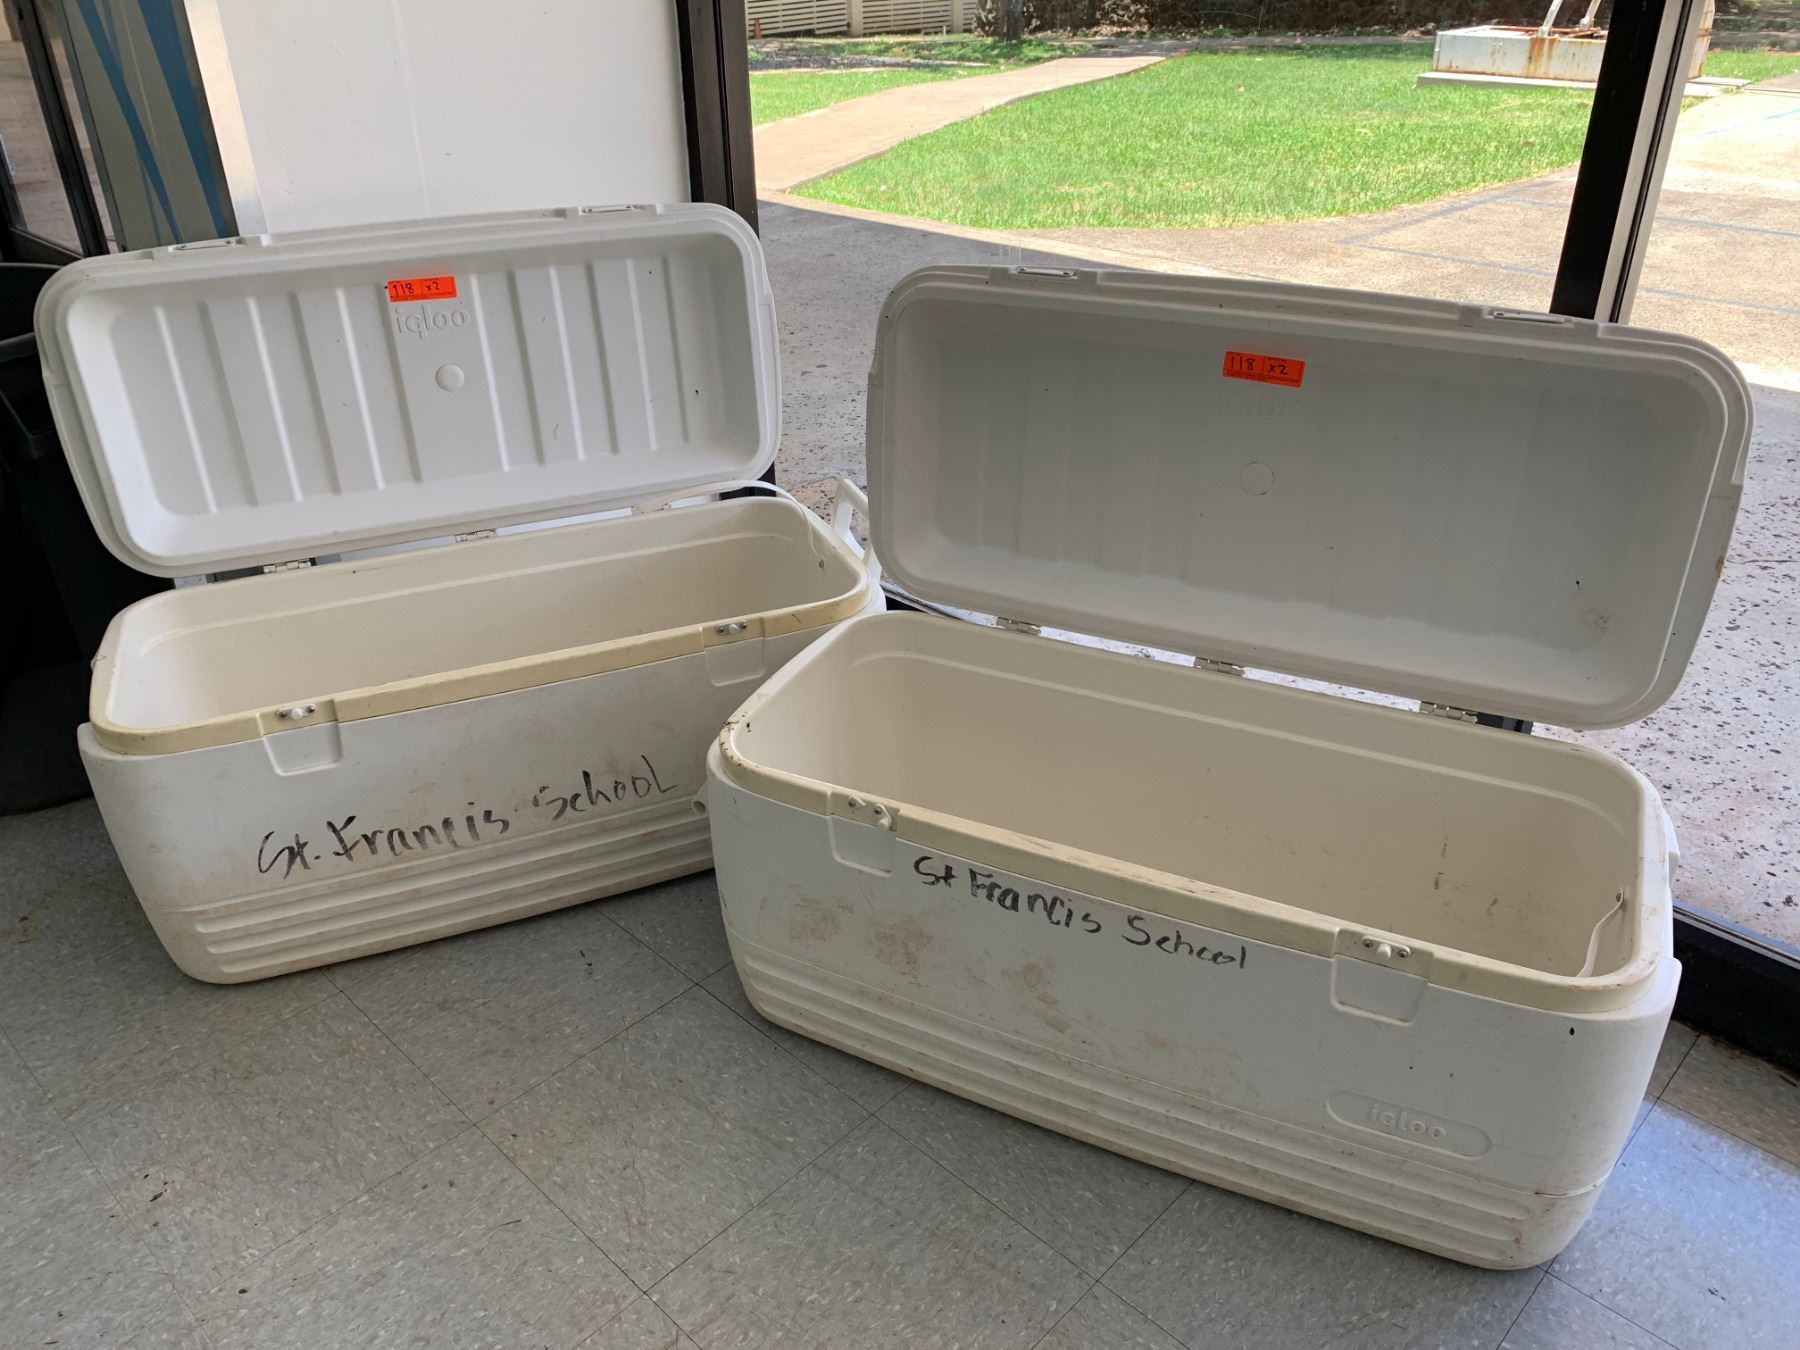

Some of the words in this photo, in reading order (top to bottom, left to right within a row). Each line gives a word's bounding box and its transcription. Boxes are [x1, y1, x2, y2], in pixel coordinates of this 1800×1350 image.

[392, 282, 415, 298] 118
[394, 305, 467, 339] igloo
[1231, 354, 1255, 371] 118
[1267, 363, 1288, 375] x2
[326, 802, 510, 863] Francis
[913, 855, 958, 888] St
[968, 868, 1102, 934] Francis
[1121, 914, 1247, 969] School
[1368, 1103, 1447, 1140] igloo
